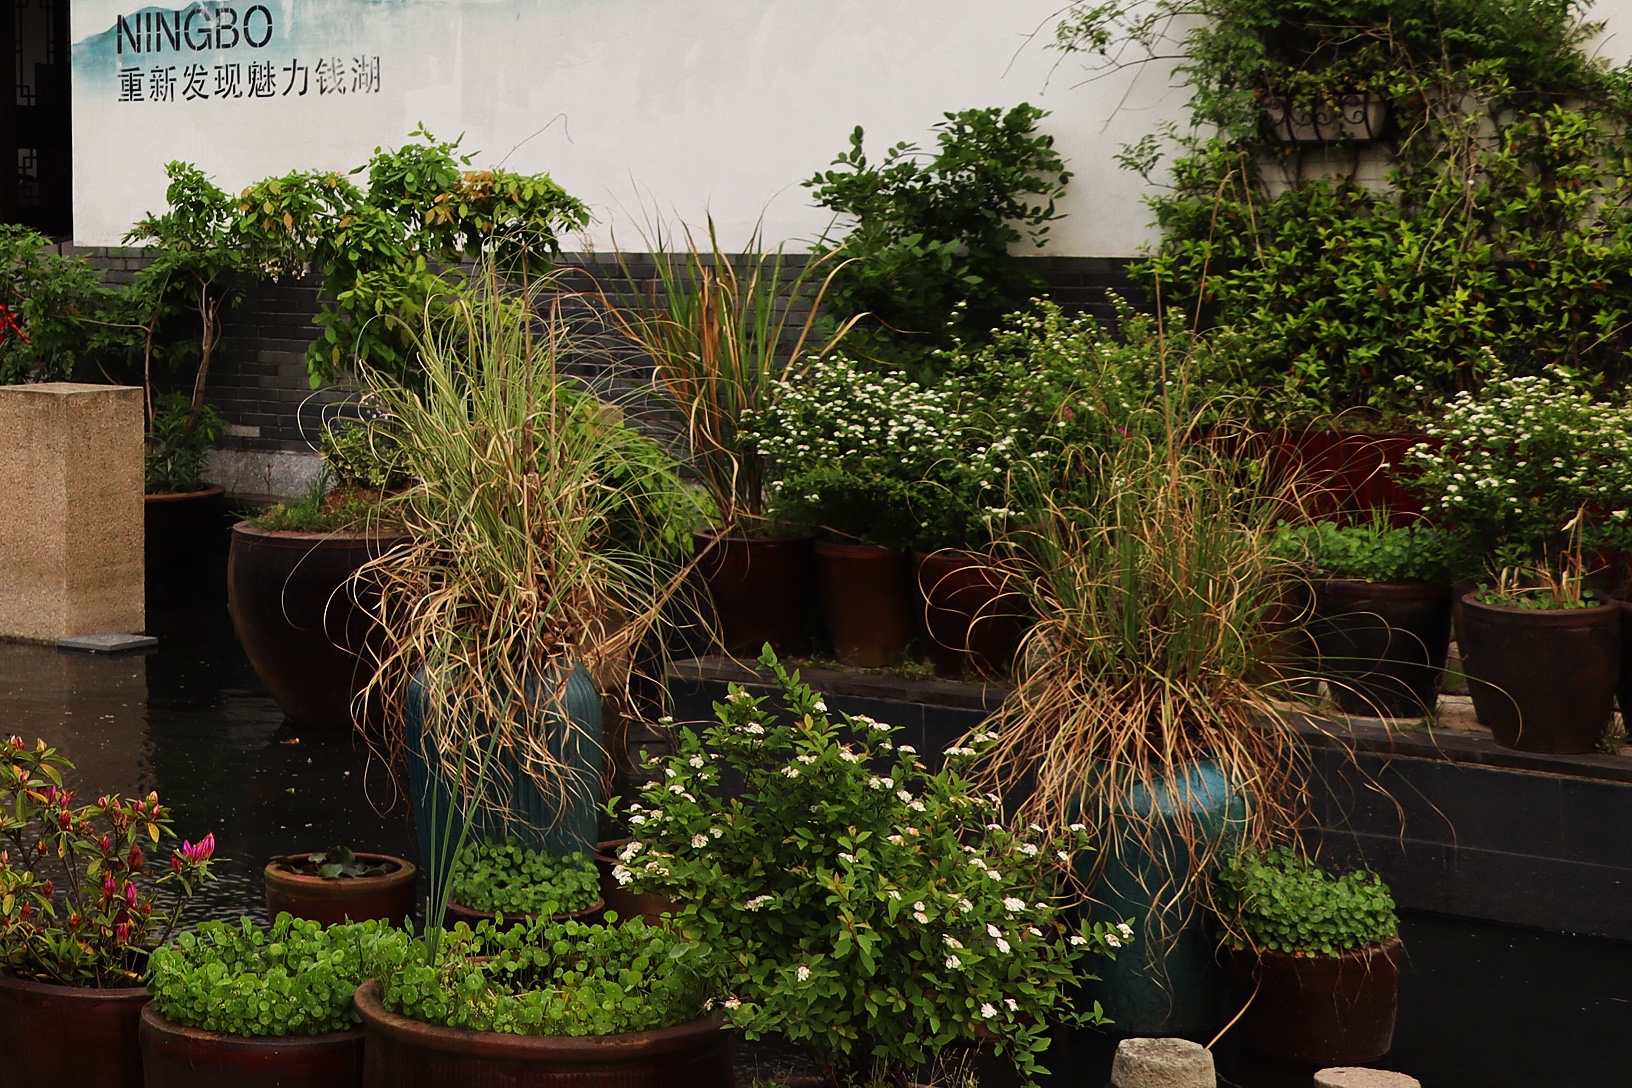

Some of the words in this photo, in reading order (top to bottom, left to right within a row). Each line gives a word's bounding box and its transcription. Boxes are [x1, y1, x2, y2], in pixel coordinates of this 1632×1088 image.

[116, 4, 274, 55] NINGBO
[117, 54, 382, 103] 重新发现魅力钱湖
